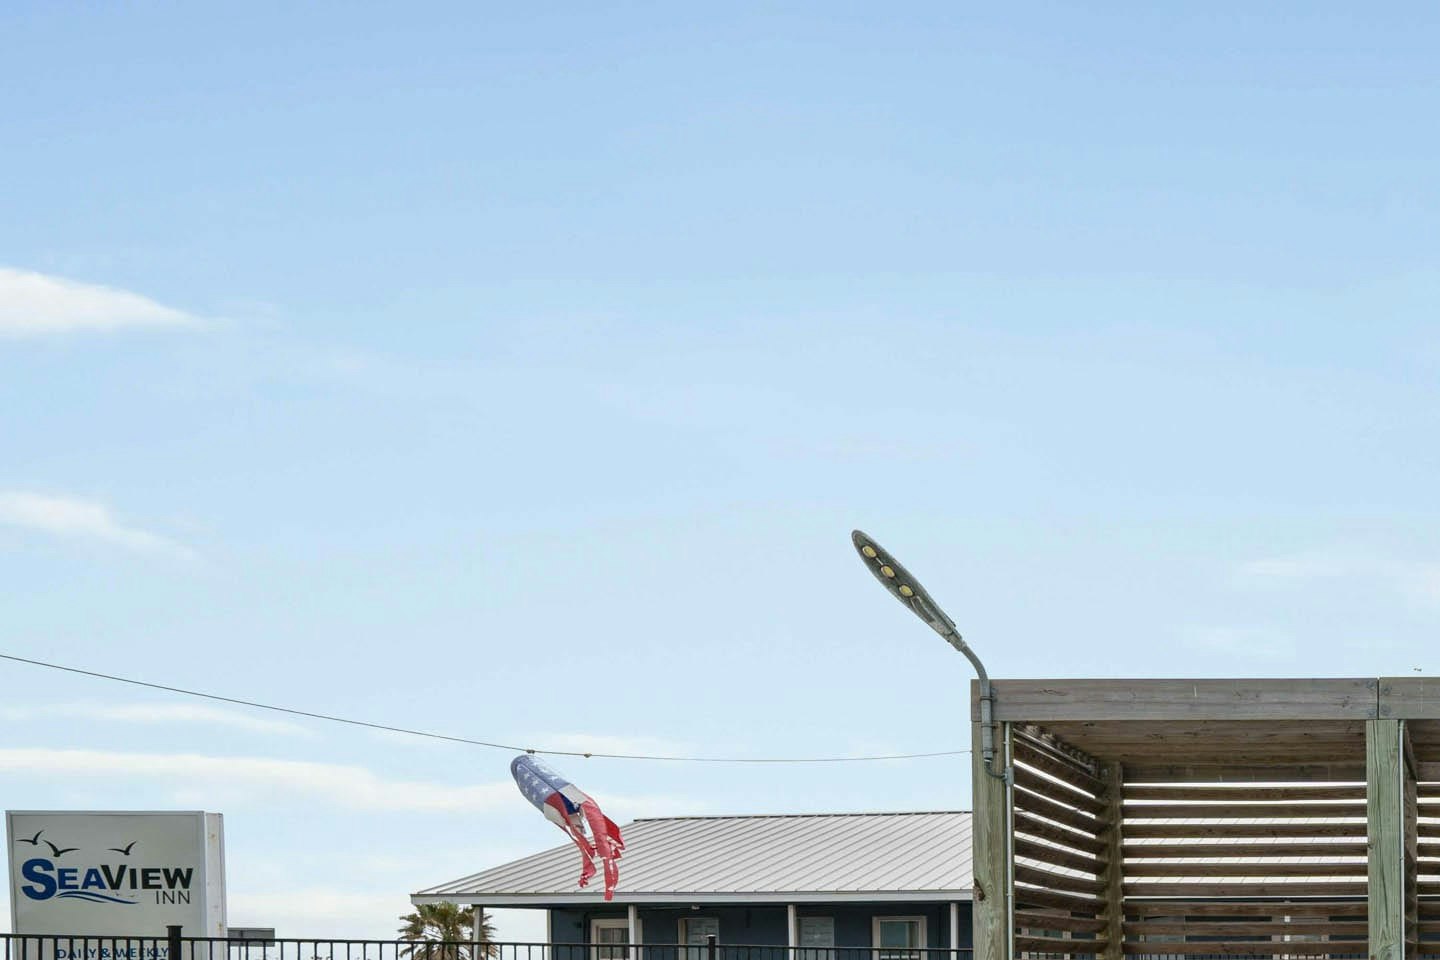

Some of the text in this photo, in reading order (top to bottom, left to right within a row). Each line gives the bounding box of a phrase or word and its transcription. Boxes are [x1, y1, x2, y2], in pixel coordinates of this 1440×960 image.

[21, 858, 194, 901] SEAVIEW
[155, 890, 191, 905] INN
[56, 948, 97, 959] DAIY
[100, 947, 111, 958] &
